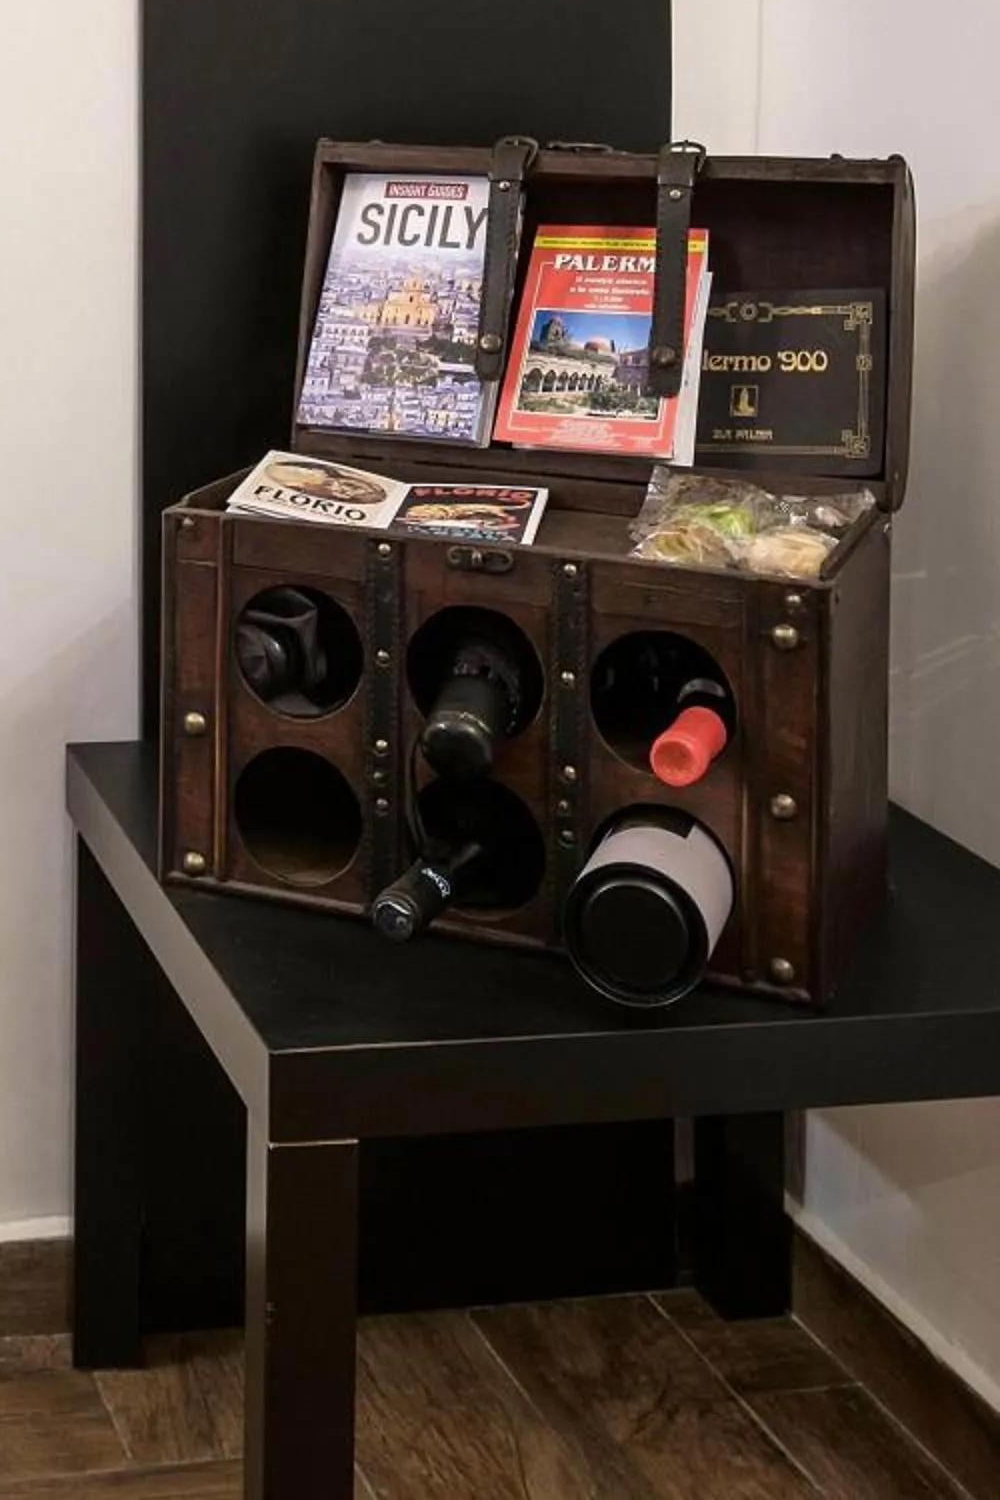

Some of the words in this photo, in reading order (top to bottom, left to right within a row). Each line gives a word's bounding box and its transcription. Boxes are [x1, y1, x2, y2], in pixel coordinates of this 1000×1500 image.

[388, 182, 427, 197] INSIGHT
[427, 184, 466, 199] GUIDES
[356, 202, 489, 250] SICILY
[553, 253, 657, 273] PALERM
[702, 350, 772, 372] lermo
[253, 485, 367, 520] FLORIO
[413, 486, 534, 500] FLORIO
